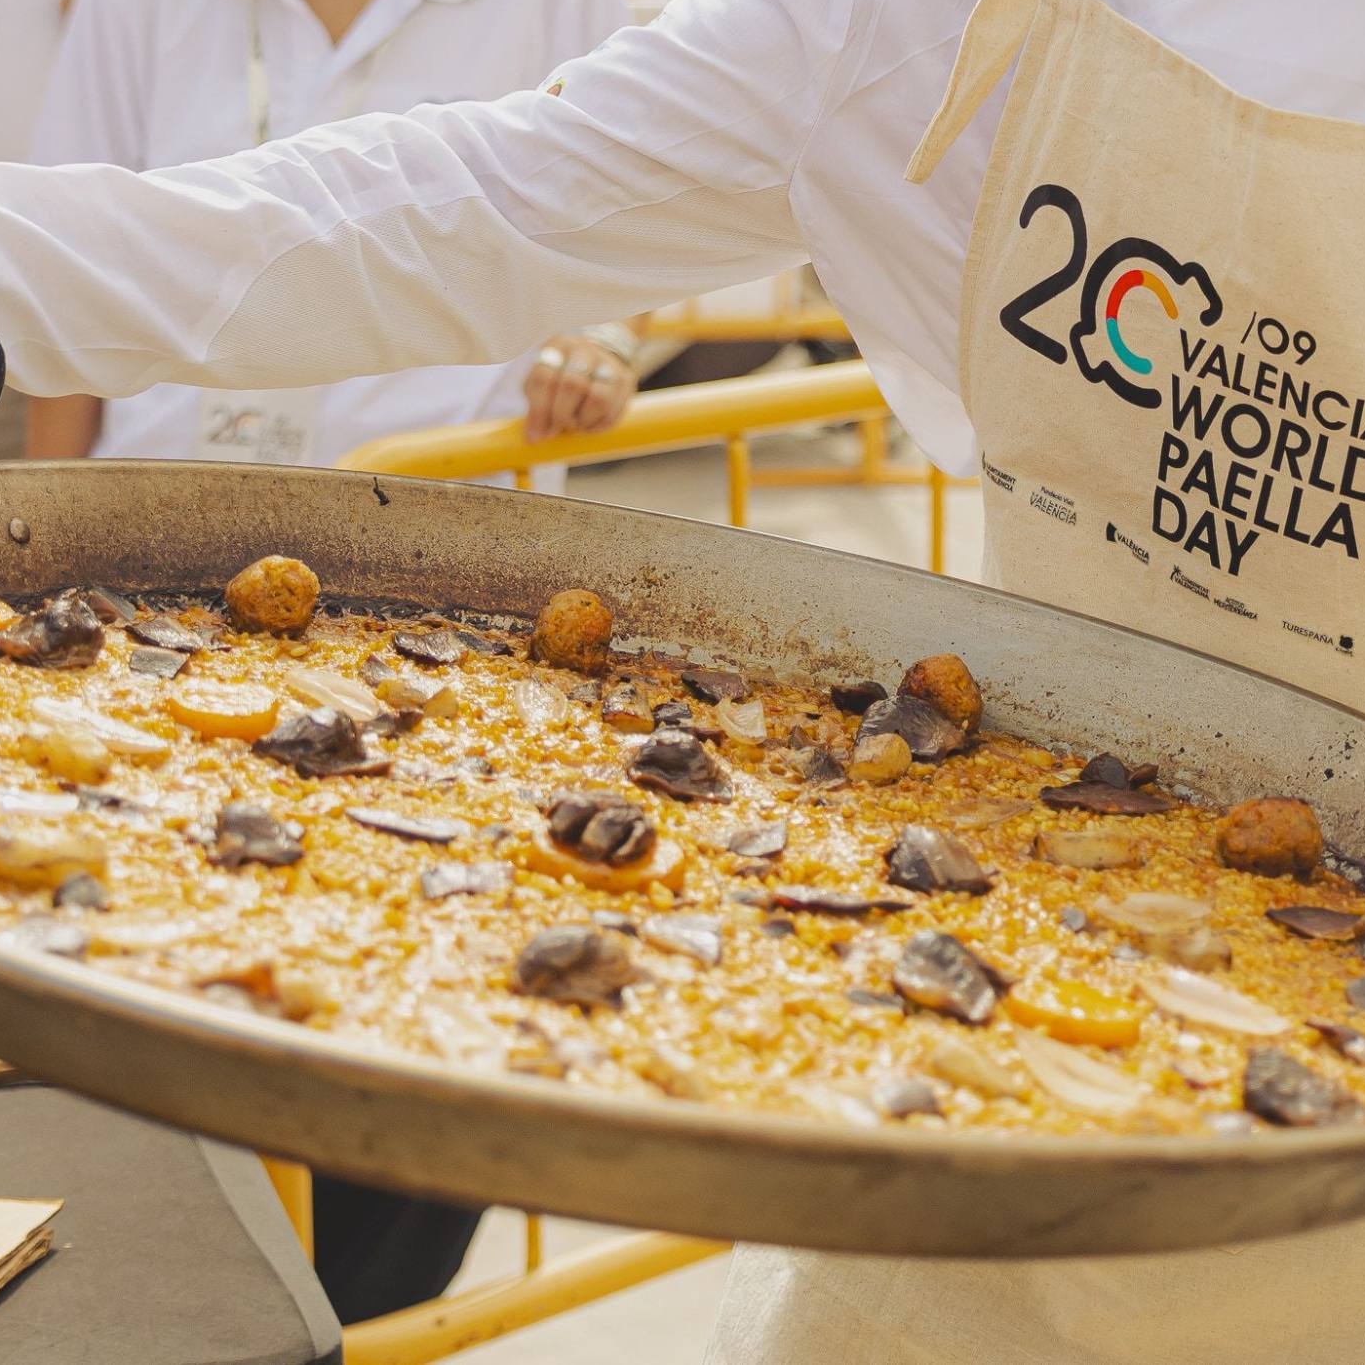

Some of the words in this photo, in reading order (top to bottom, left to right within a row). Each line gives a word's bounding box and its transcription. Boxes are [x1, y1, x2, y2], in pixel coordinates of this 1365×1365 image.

[1240, 311, 1317, 366] /09
[1152, 485, 1260, 576] DAY
[1158, 431, 1359, 560] PAELLA
[1282, 620, 1334, 646] TURESPAÑA
